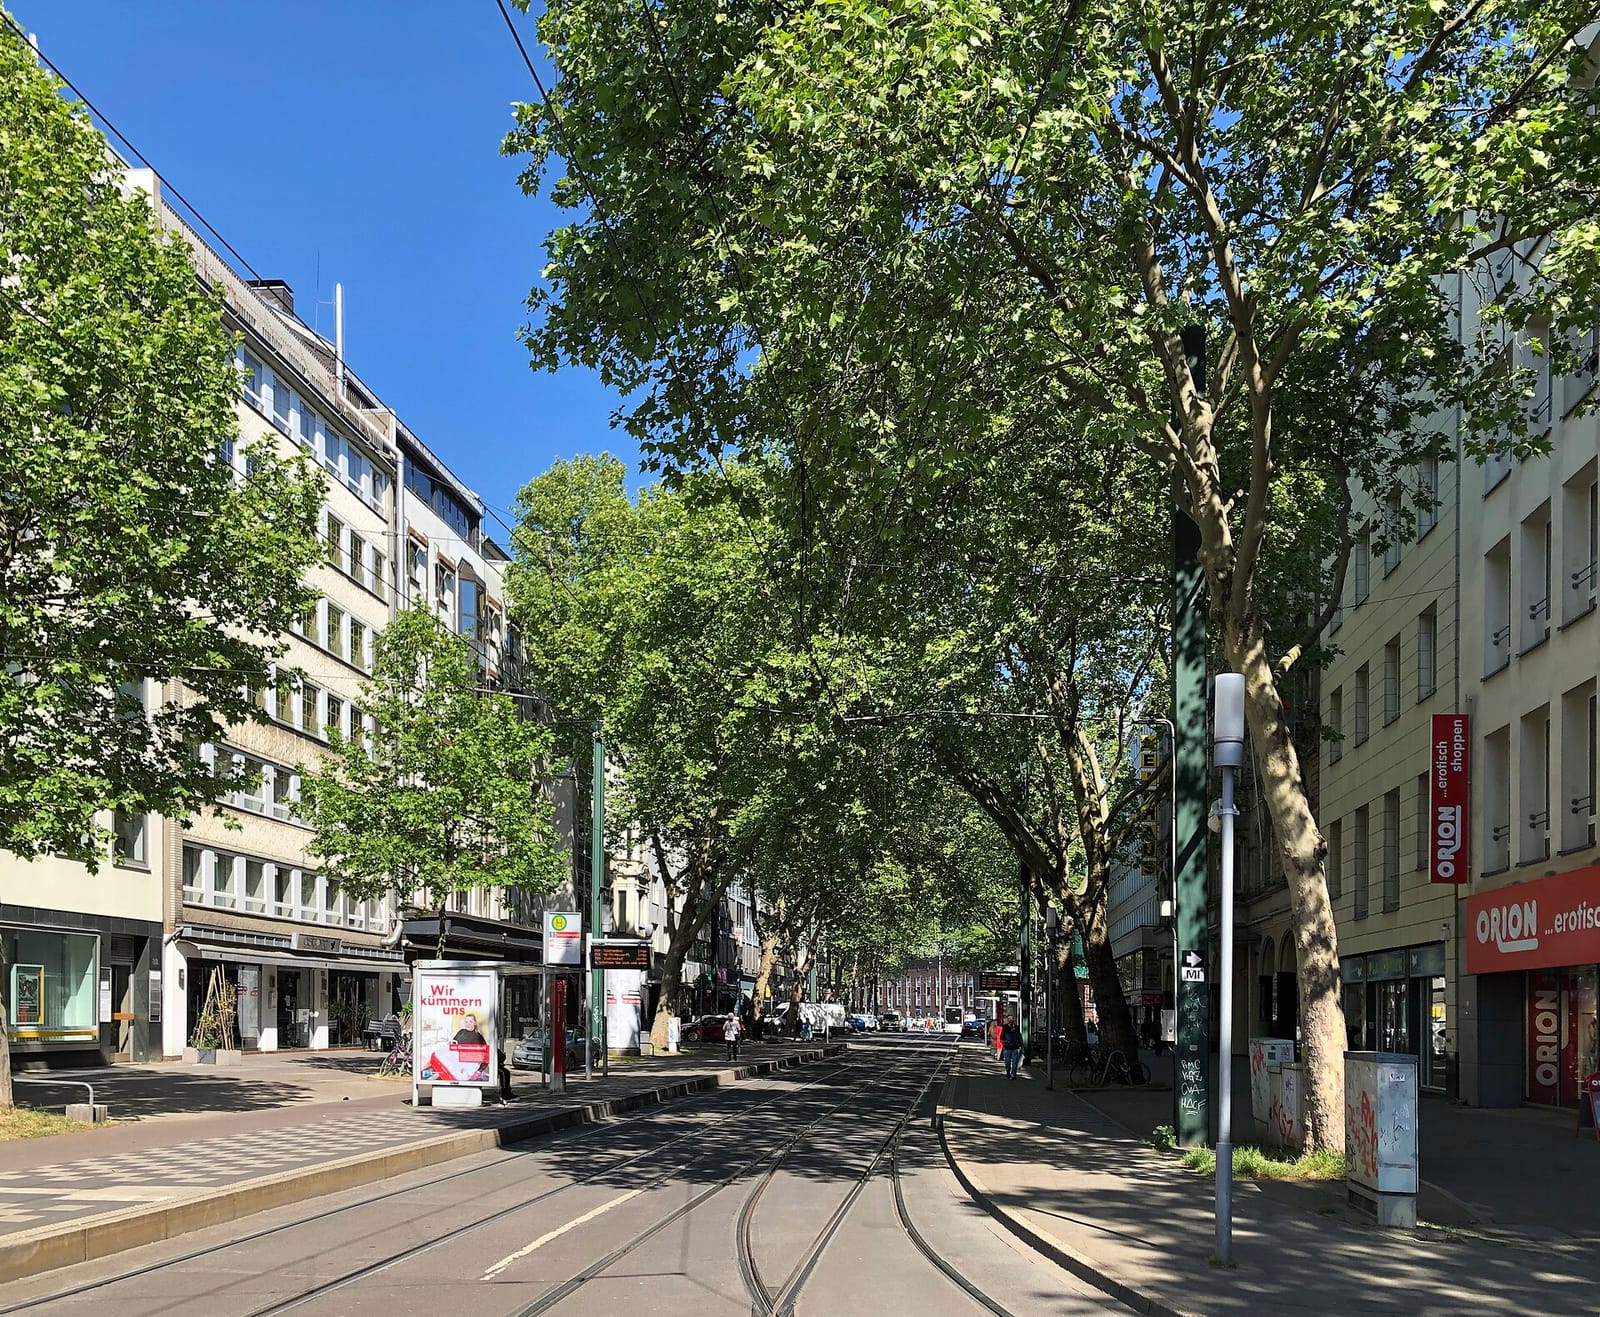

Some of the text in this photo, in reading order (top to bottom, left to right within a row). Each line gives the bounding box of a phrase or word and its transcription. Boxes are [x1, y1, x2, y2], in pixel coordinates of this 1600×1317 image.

[1436, 741, 1447, 797] ...erotisch
[1451, 719, 1465, 772] shoppen
[1437, 804, 1462, 878] ORION
[1476, 899, 1539, 953] ORION
[421, 995, 482, 1007] kümmern
[430, 984, 455, 996] Wir
[443, 1006, 466, 1016] uns
[1535, 989, 1568, 1086] ORION
